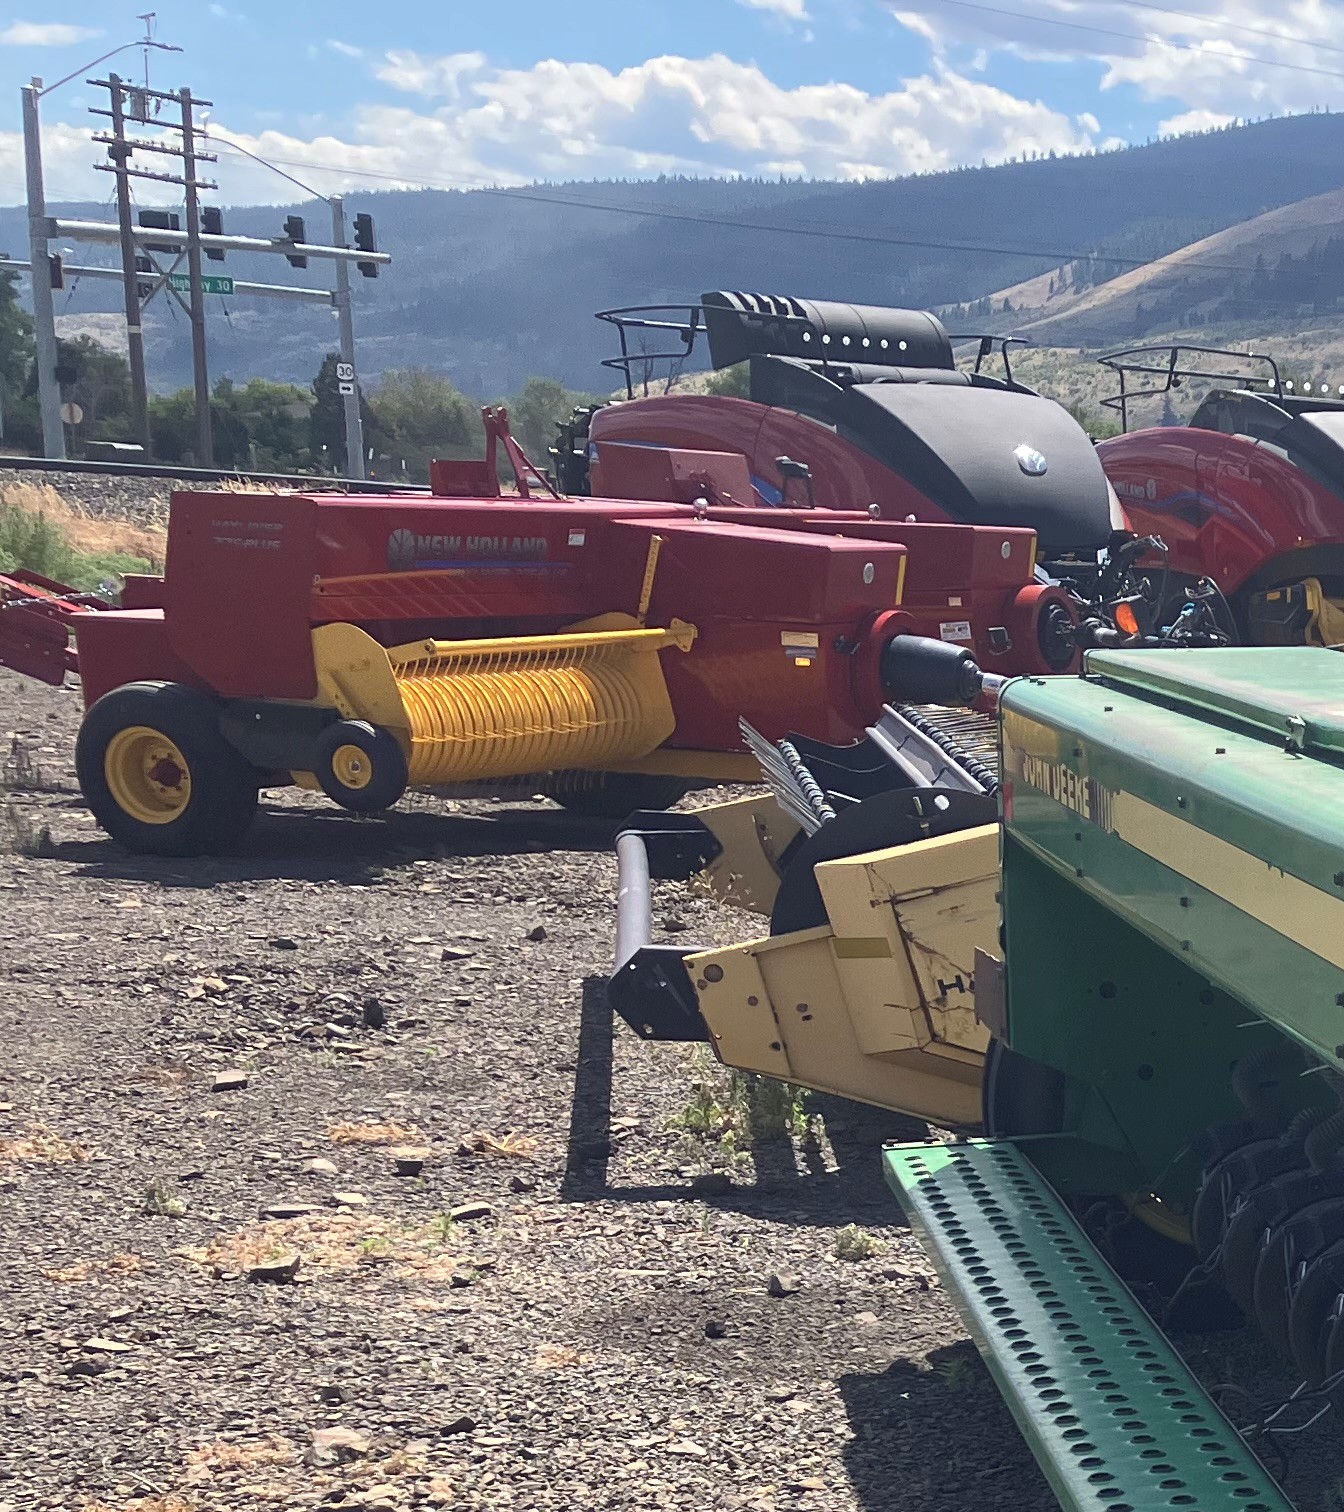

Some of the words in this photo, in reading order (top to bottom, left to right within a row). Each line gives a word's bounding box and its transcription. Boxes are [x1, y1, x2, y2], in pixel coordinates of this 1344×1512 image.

[217, 280, 230, 291] 30
[339, 366, 351, 377] 30
[417, 535, 461, 557] NEW
[465, 536, 548, 559] HOLLAND
[1052, 763, 1090, 820] DEERE
